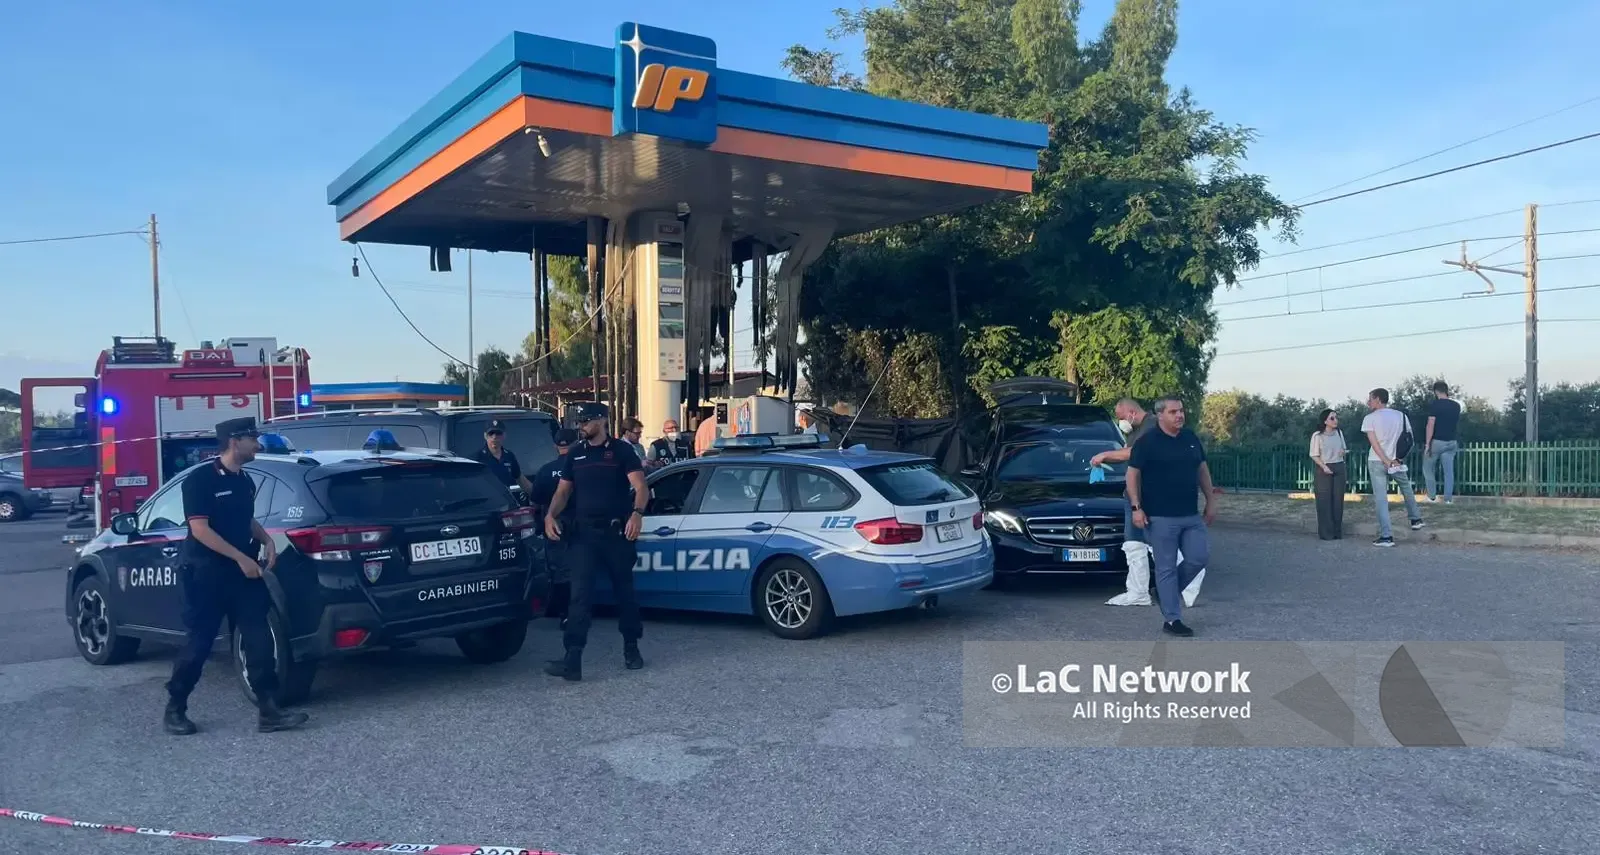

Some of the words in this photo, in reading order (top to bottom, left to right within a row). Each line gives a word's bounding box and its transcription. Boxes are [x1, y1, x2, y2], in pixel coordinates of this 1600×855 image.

[632, 63, 709, 112] IP
[190, 351, 226, 360] BAI
[287, 506, 304, 518] 1515
[820, 516, 857, 529] 113
[414, 544, 430, 559] CC
[499, 547, 516, 560] 1515
[418, 579, 499, 601] CARABINIERI
